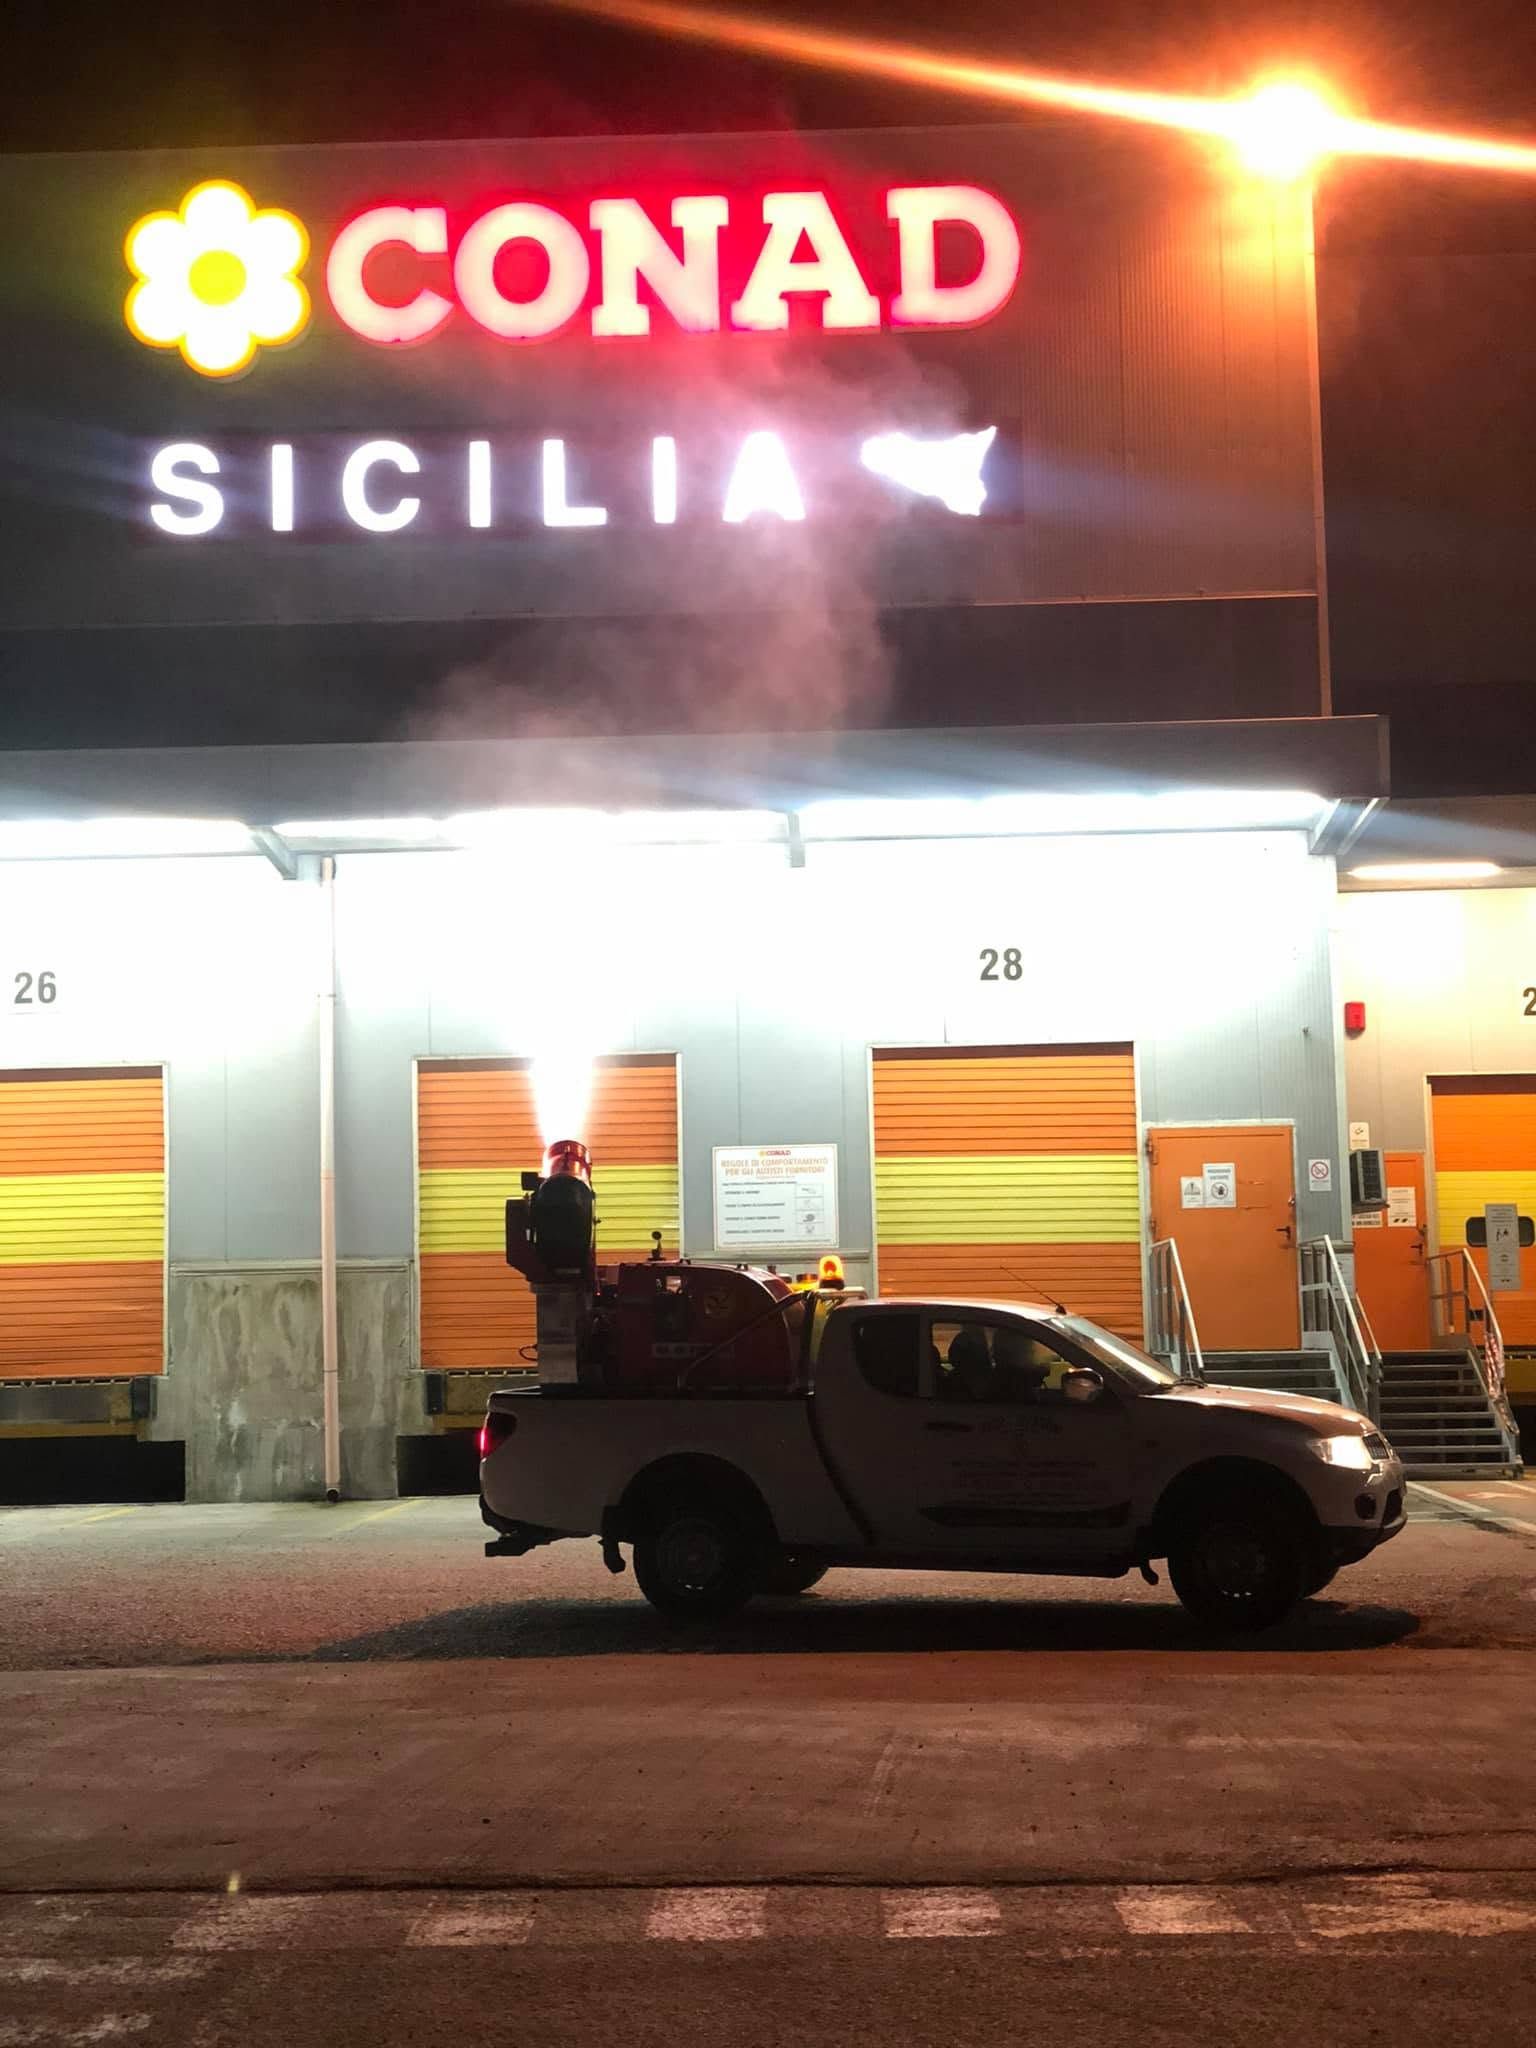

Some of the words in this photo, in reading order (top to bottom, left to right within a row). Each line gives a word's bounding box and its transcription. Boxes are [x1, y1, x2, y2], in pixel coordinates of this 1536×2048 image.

[326, 185, 1021, 343] CONAD
[150, 431, 806, 535] SICILIA
[14, 971, 56, 1004] 26
[980, 947, 1023, 981] 28
